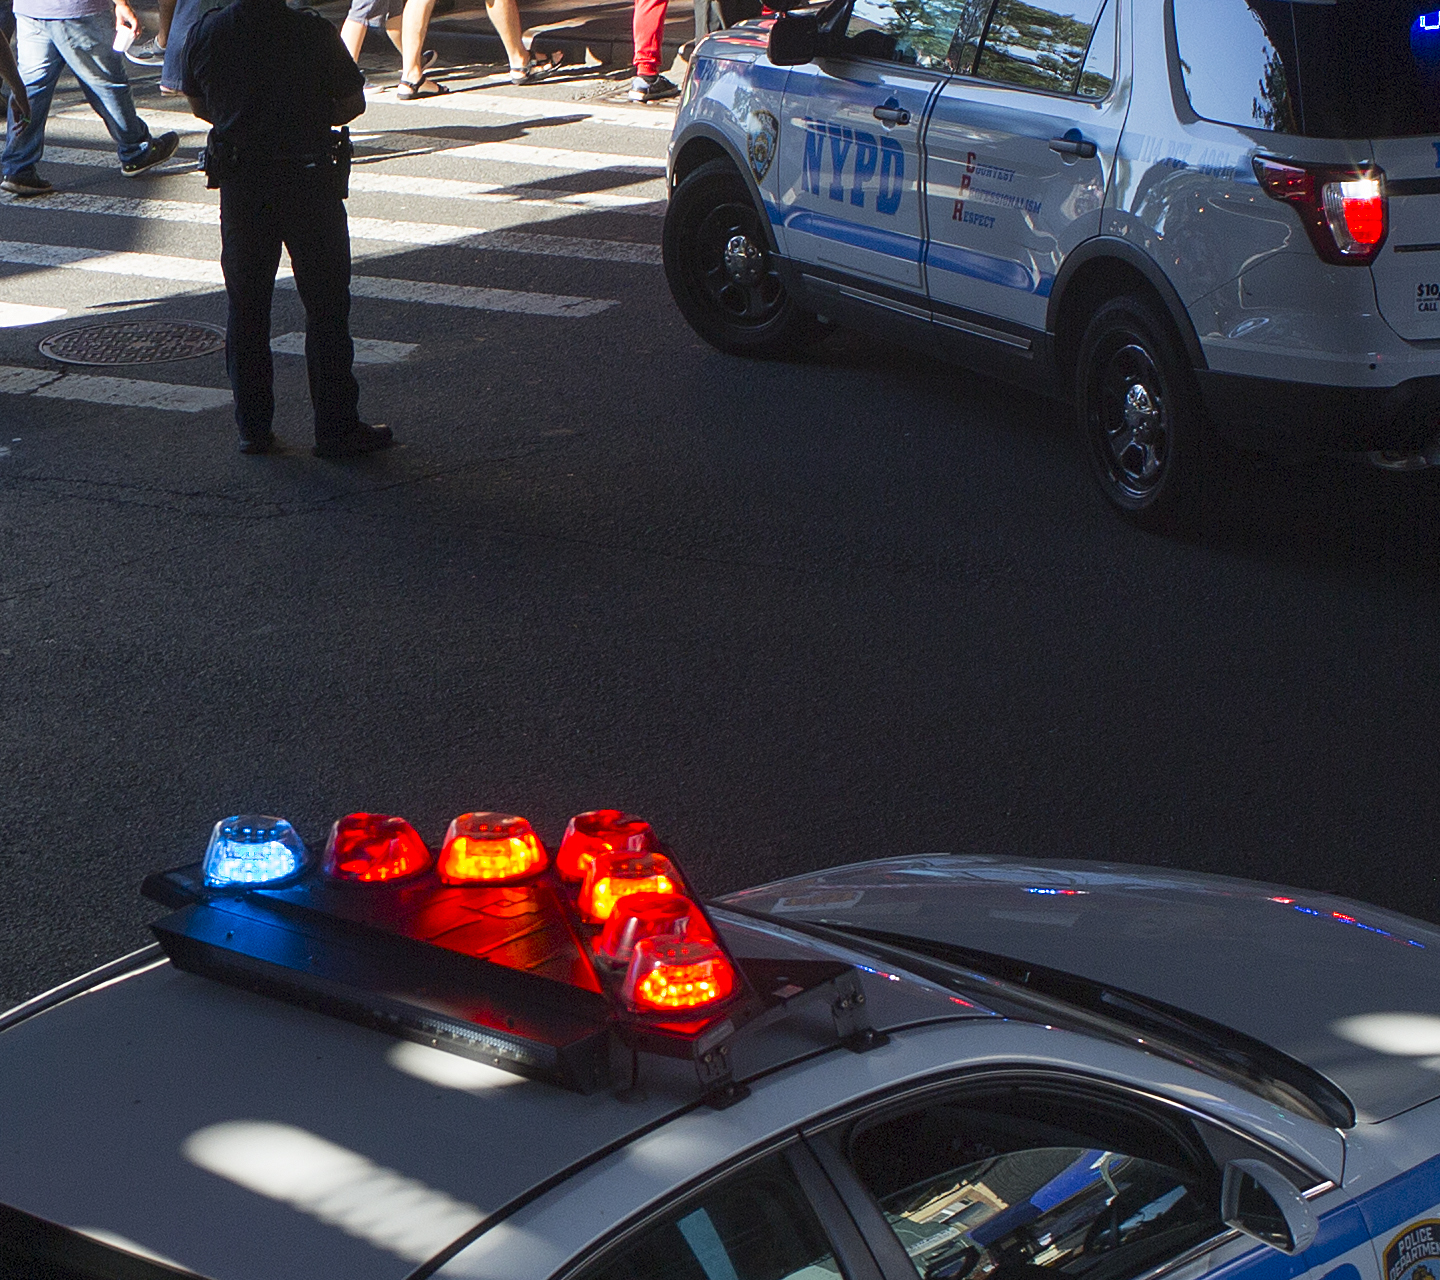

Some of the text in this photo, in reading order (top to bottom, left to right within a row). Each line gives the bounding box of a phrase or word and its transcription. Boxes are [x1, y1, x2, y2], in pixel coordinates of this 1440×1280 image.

[801, 115, 905, 216] NYPD
[952, 199, 996, 229] RESPECT
[1398, 1226, 1434, 1256] POLICE
